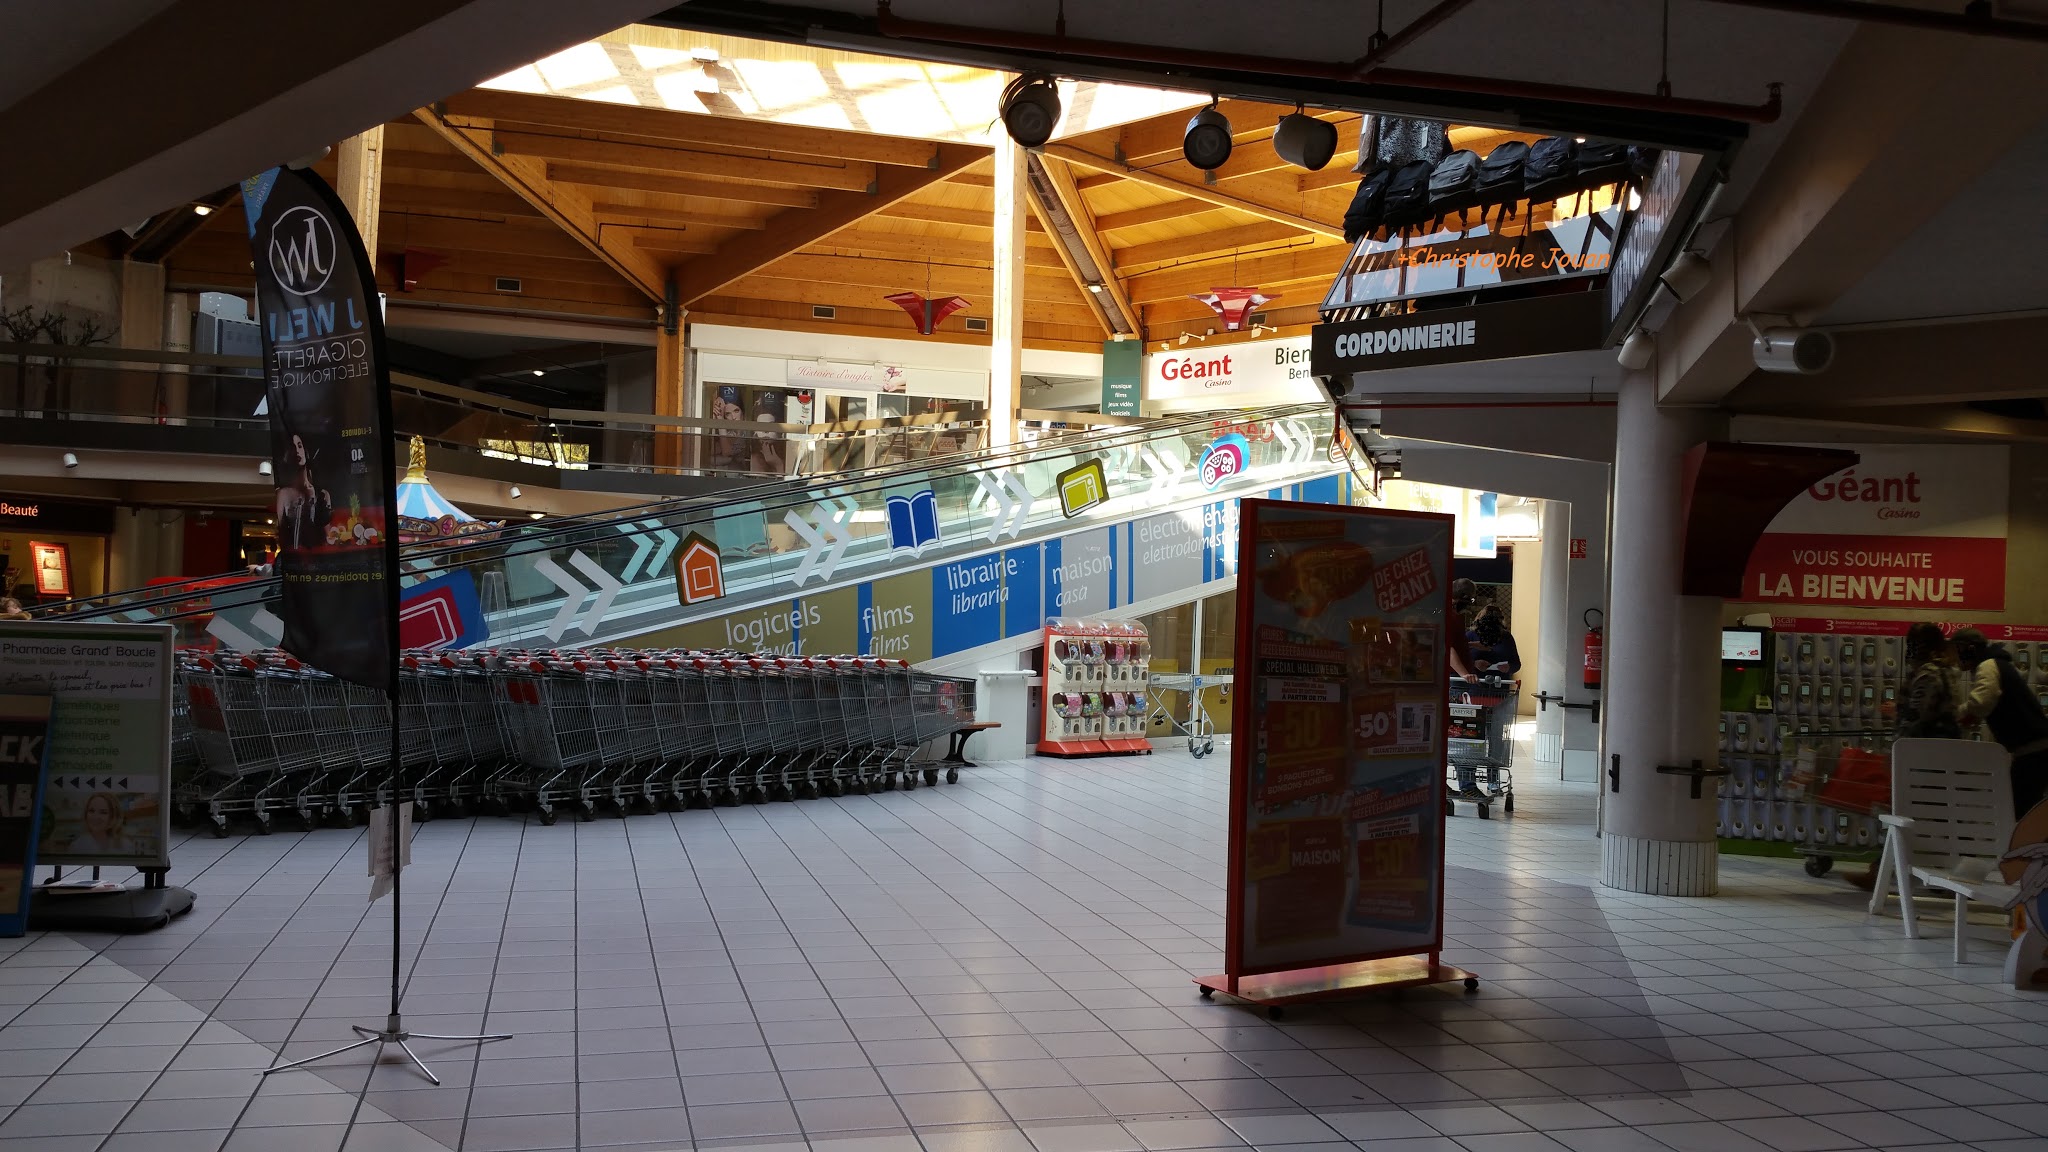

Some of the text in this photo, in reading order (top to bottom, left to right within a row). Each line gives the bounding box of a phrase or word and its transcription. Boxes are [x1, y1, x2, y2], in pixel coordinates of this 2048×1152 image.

[1541, 247, 1611, 270] Jouan
[1335, 320, 1476, 359] CORDONNERIE
[797, 366, 873, 381] Histoire d'ongles
[1161, 354, 1232, 381] Géant
[1204, 378, 1232, 388] Casino
[1107, 401, 1119, 409] jeux
[1807, 469, 1921, 503] Géant
[0, 502, 39, 517] Beauté
[1877, 507, 1921, 520] Casino
[1052, 554, 1113, 585] maison
[1374, 567, 1391, 589] DE
[1392, 549, 1428, 580] CHEZ
[1792, 549, 1933, 569] VOUS SOUHAITE
[946, 555, 1018, 591] librairie
[1055, 585, 1088, 608] casa
[1378, 570, 1433, 611] GÉANT
[1759, 572, 1964, 603] LA BIENVENUE
[952, 585, 1010, 616] libraria
[725, 600, 821, 646] logiciels
[862, 604, 915, 634] films
[1825, 619, 1835, 630] 3
[2003, 625, 2013, 637] 3
[3, 643, 67, 656] Pharmacie
[116, 646, 156, 658] Boucle
[869, 633, 910, 656] films
[1266, 660, 1295, 673] SPÉCIAL
[1292, 848, 1341, 867] MAISON
